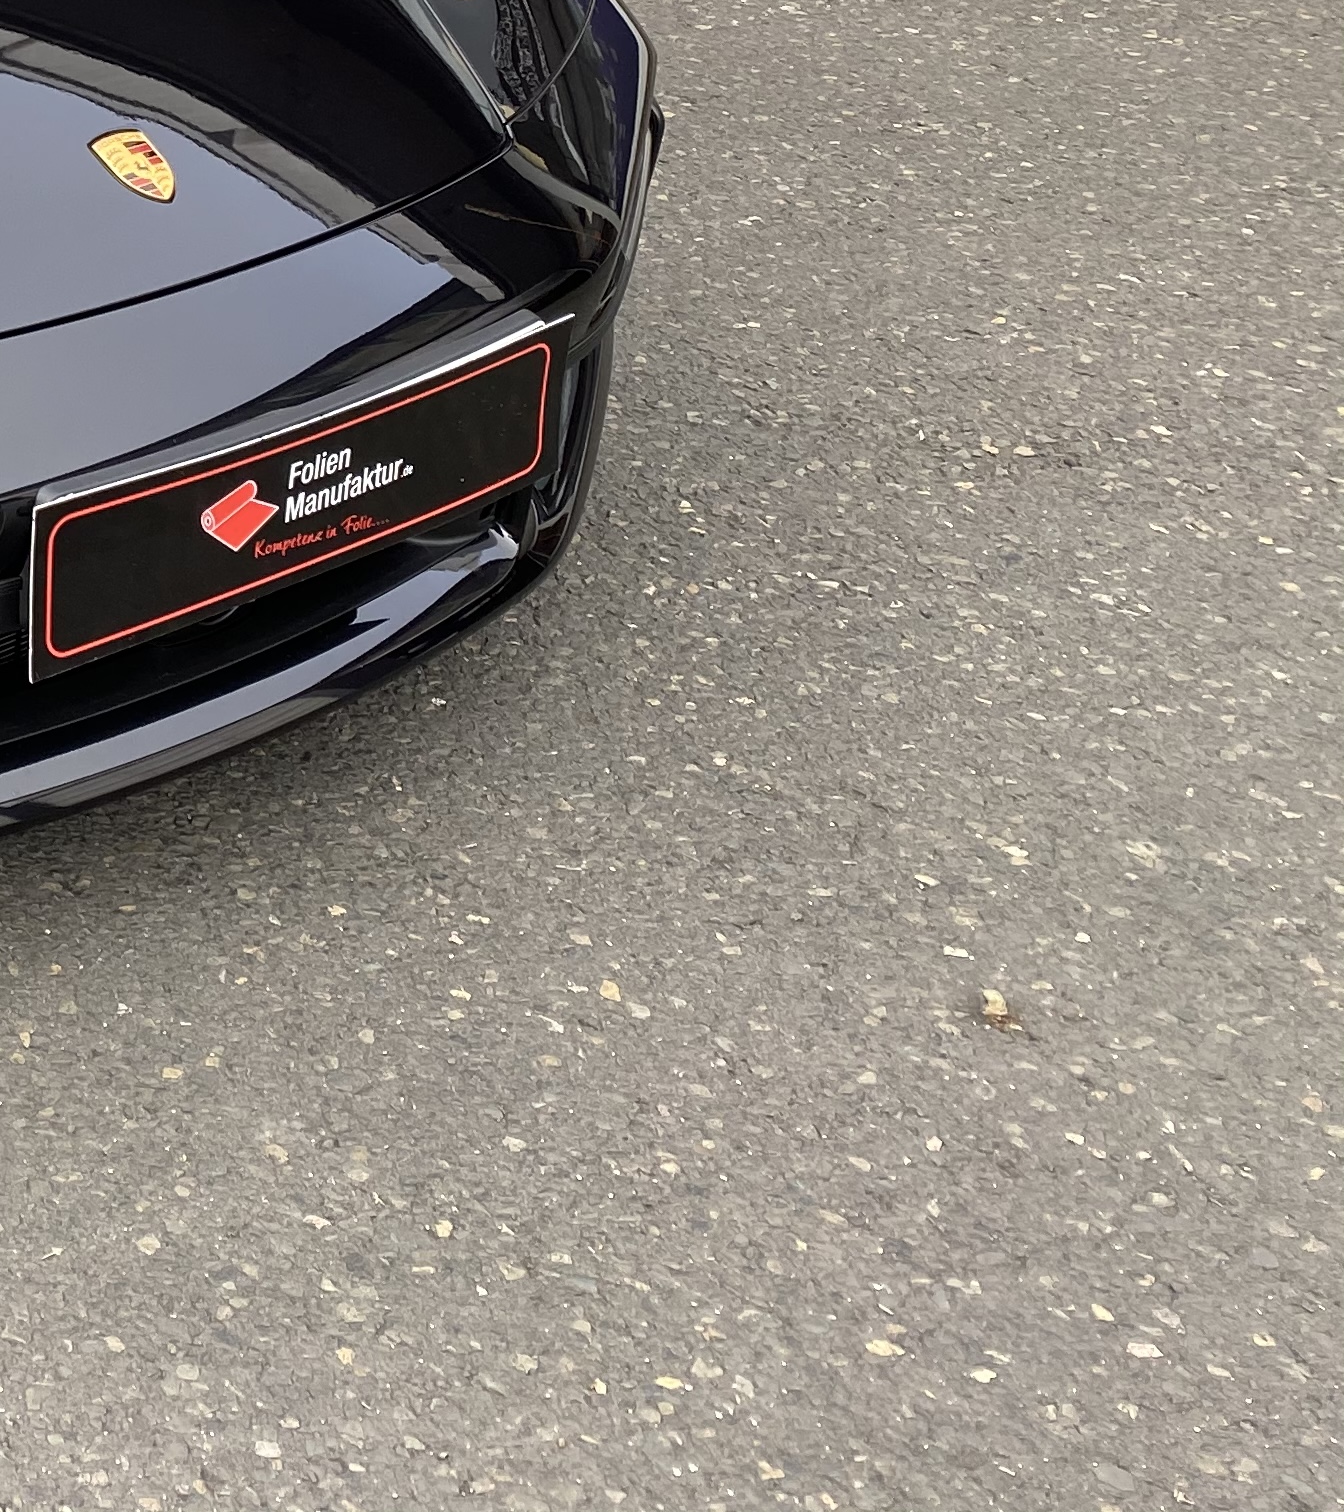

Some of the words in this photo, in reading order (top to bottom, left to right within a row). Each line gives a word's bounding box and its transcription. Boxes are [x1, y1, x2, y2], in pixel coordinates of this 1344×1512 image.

[288, 448, 351, 490] Folien
[284, 458, 414, 524] Manufaktur.de
[254, 530, 323, 559] Kompetenz
[325, 524, 338, 539] in
